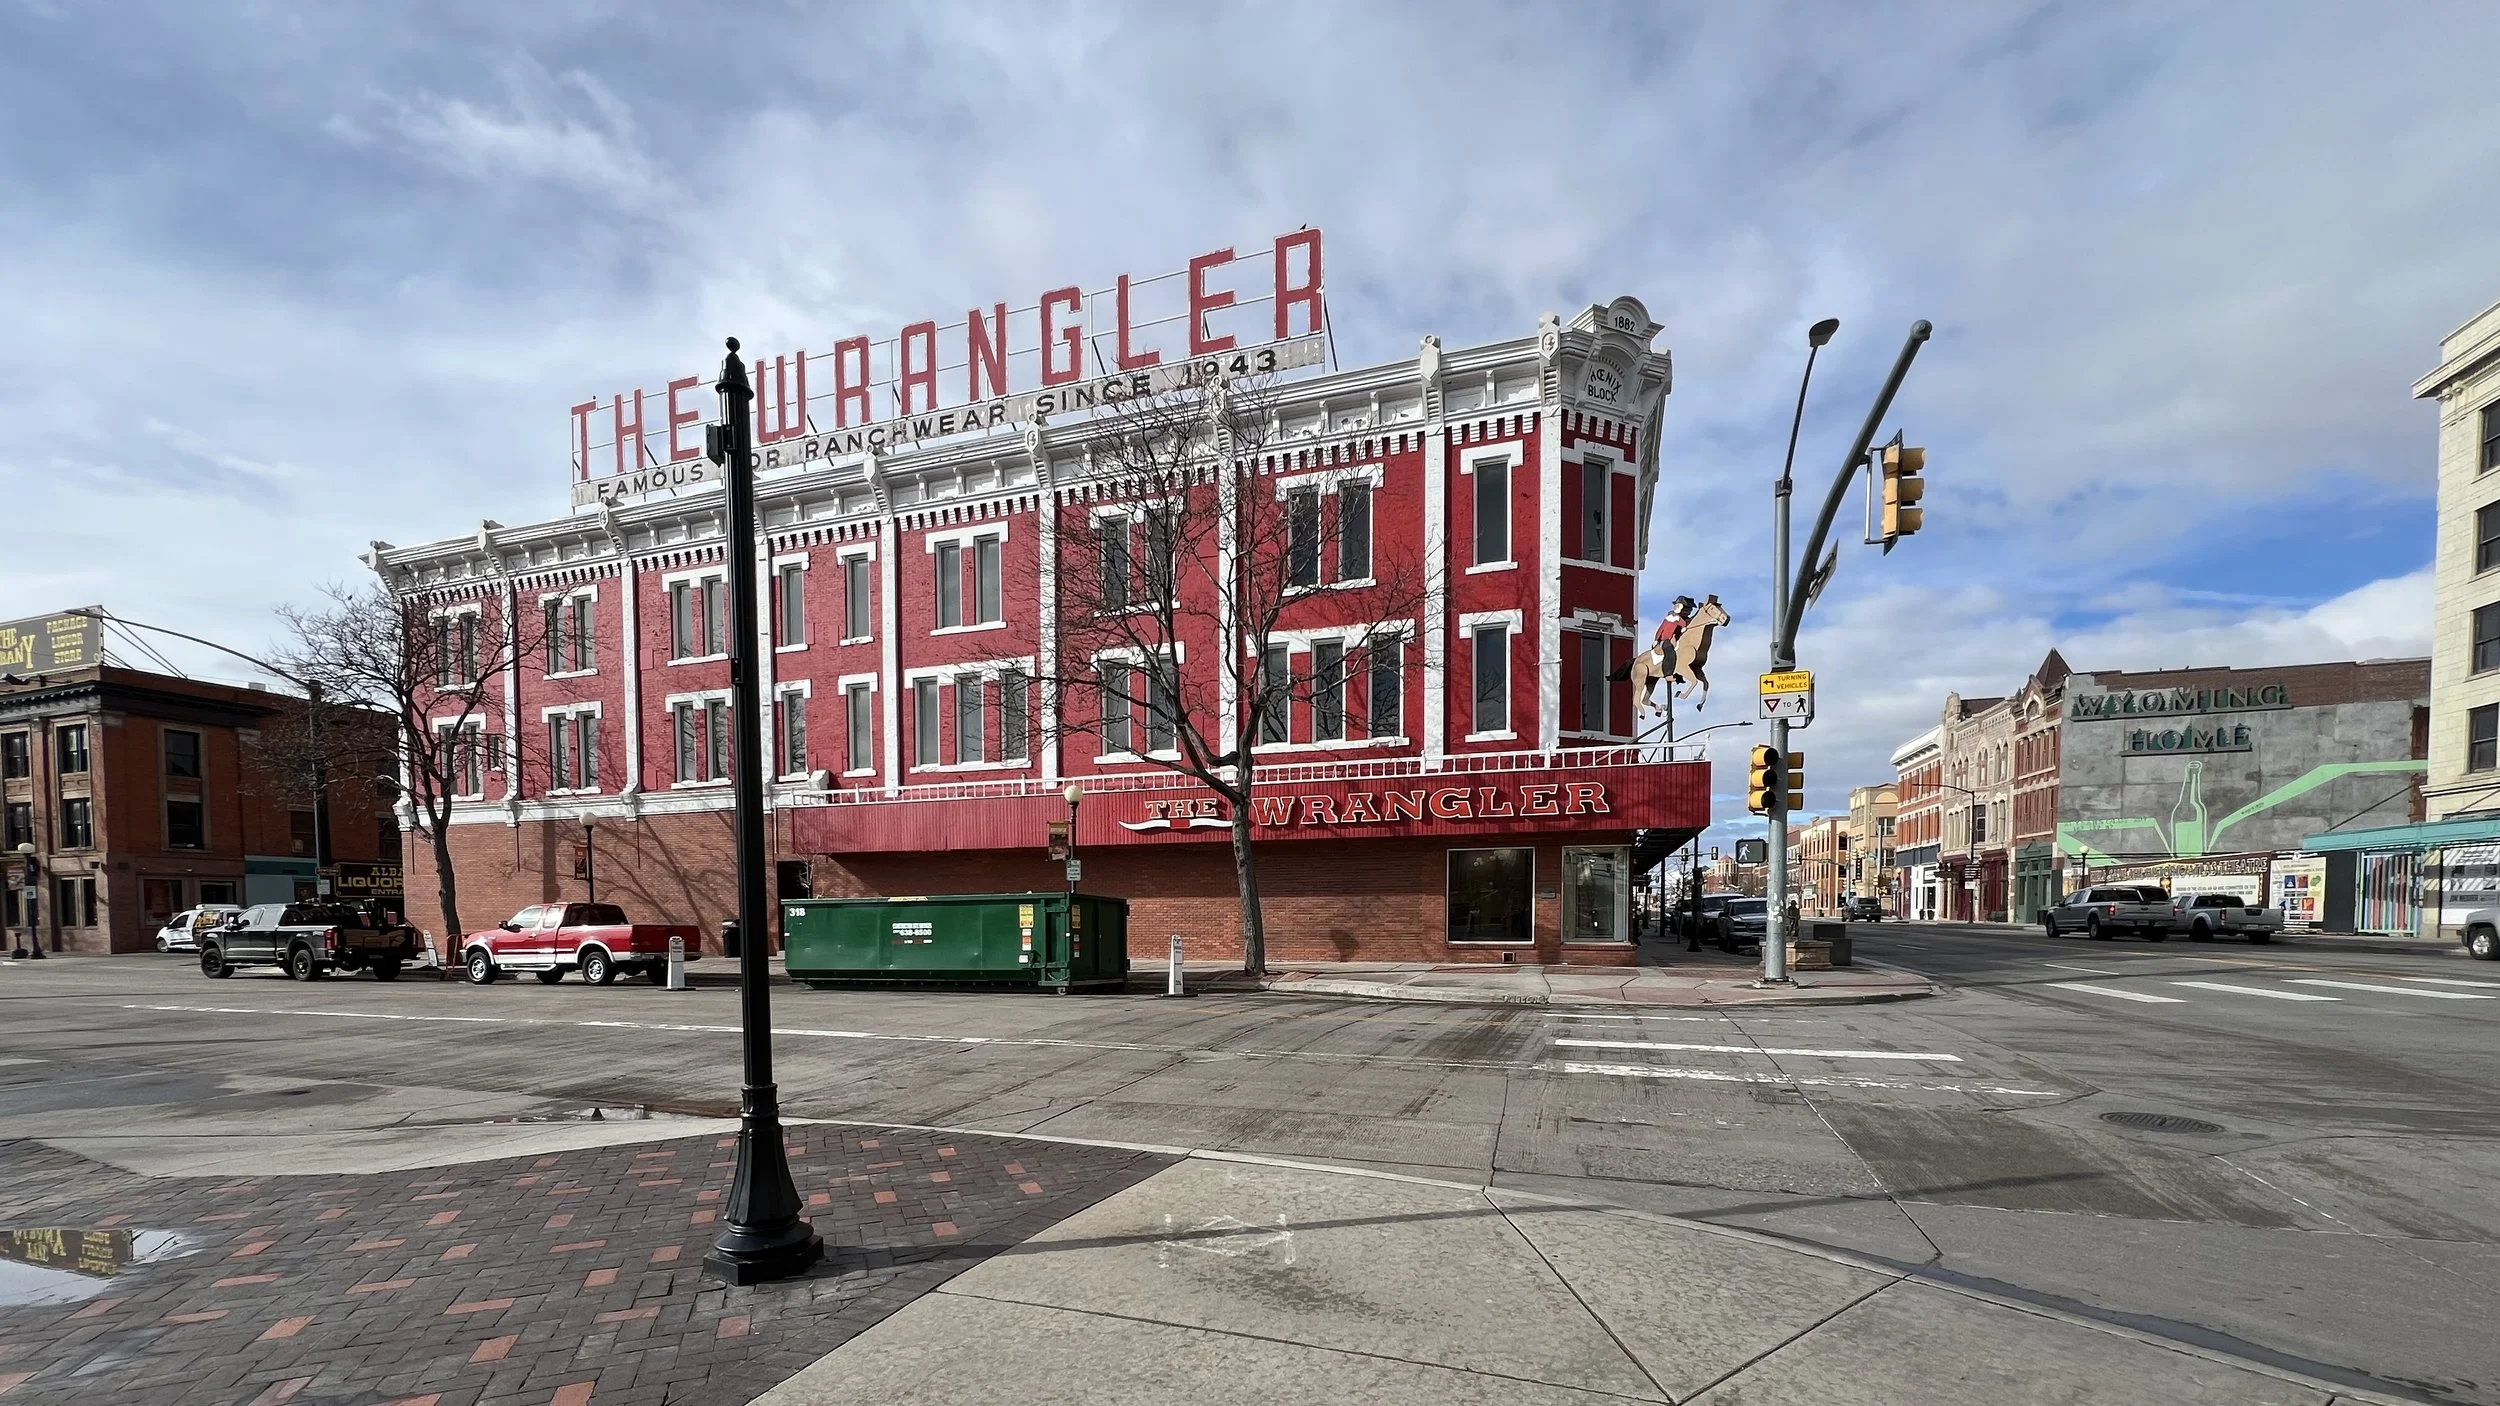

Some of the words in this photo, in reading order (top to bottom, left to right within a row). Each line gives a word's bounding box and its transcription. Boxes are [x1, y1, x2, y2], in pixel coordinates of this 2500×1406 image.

[1614, 315, 1636, 332] 1882
[571, 375, 700, 480] THE
[755, 228, 1323, 446] WRANGLER
[1587, 384, 1617, 405] BLOCK
[597, 464, 704, 499] FAMOUS
[751, 448, 780, 470] OR
[804, 405, 1007, 460] RANCHWEAR
[1036, 374, 1152, 415] SINCE
[1184, 349, 1276, 386] 1943
[1776, 682, 1808, 690] VEHICLES
[1777, 674, 1807, 682] TURNING
[2077, 684, 2284, 717] WYOMING
[2128, 725, 2252, 751] HOME
[1144, 798, 1218, 819] THE
[1250, 781, 1611, 827] WRANGLER
[2219, 857, 2268, 875] THEATRE
[789, 907, 806, 917] 318
